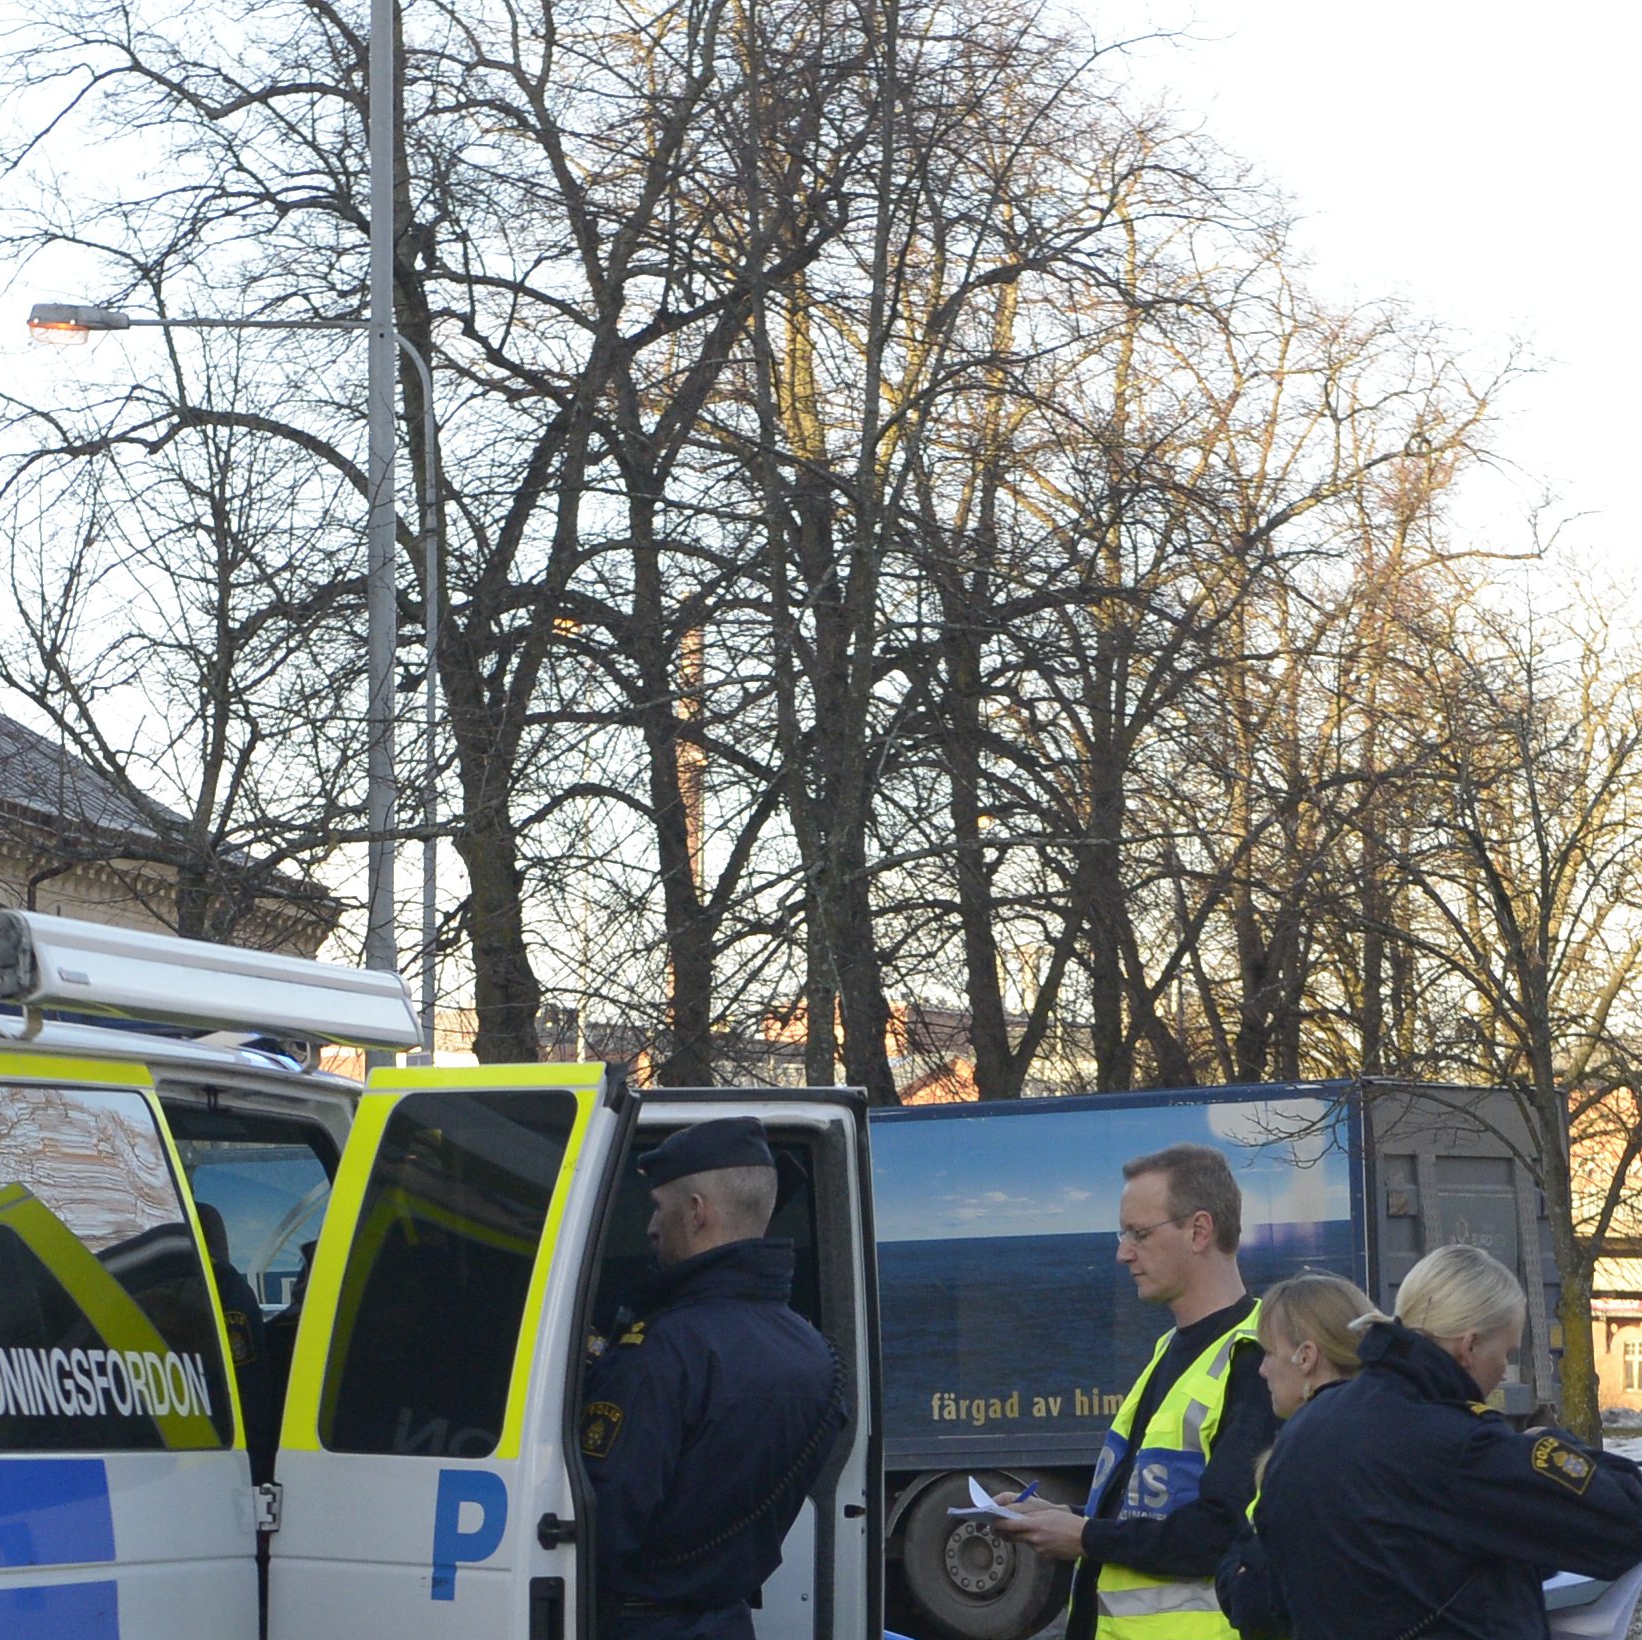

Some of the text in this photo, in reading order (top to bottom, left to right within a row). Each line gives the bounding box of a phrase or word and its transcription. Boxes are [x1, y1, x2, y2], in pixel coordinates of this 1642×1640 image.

[931, 1388, 1125, 1426] färgad av him
[431, 1469, 508, 1600] P
